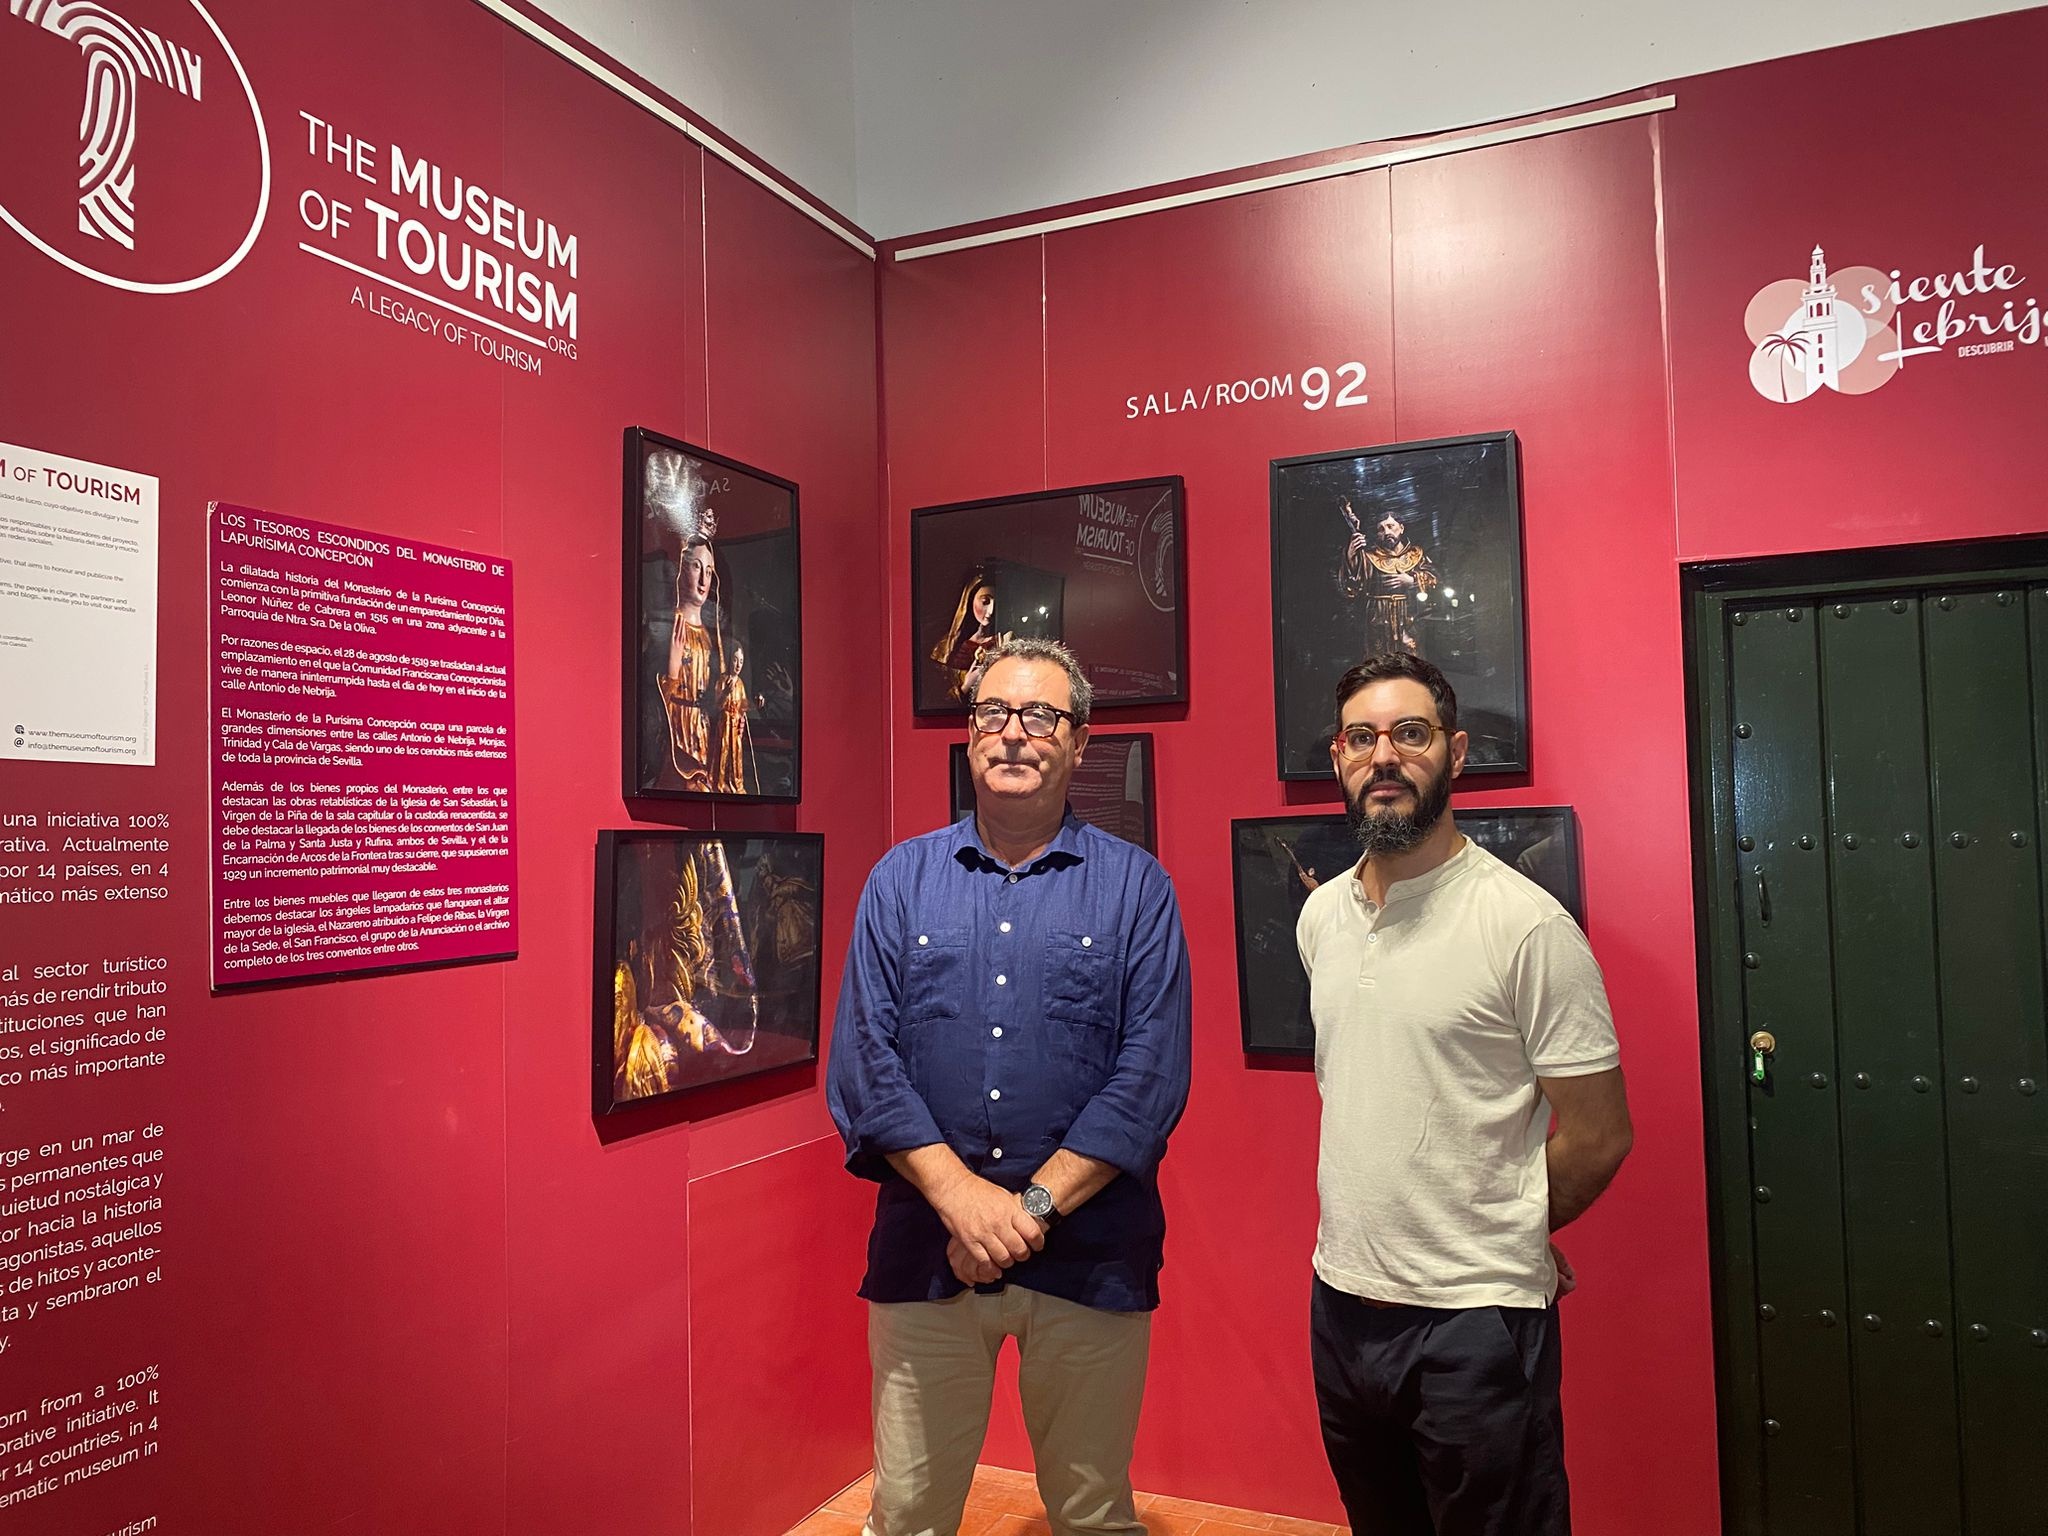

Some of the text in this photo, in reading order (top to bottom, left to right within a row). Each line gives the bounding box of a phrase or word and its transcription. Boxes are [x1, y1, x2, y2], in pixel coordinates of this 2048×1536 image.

[299, 110, 577, 279] THE MUSEUM
[299, 189, 577, 340] OF TOURISM
[1860, 244, 2026, 314] siente
[350, 286, 541, 376] A LEGACY OF TOURISM
[1958, 340, 2014, 358] DESCUBRIR
[1300, 361, 1369, 411] 92
[13, 466, 38, 484] OF
[42, 467, 141, 506] TOURISM
[220, 511, 505, 577] LOS TESOROS ESCONDIDOS DEL MONASTERIO DE
[297, 543, 374, 569] CONCEPCIÓN
[220, 560, 506, 615] La dilatada historia del Monasterio de la Purísima Concepción
[220, 604, 378, 635] Parroquia de Ntra. Sra. De la Oliva.
[220, 678, 337, 699] calle Antonio de Nebrija.
[27, 730, 137, 744] www.themuseumoftourism.org
[221, 751, 364, 767] de toda la provincia de Sevilla.
[3, 811, 170, 829] una iniciativa 100%
[62, 836, 170, 852] Actualmente
[37, 864, 57, 880] 14
[65, 860, 123, 881] países,
[130, 863, 152, 876] en
[158, 862, 169, 877] 4
[222, 861, 439, 882] 1929 un incremento patrimonial muy destacable.
[61, 885, 98, 902] más
[104, 885, 169, 901] extenso
[1, 955, 168, 982] al sector turístico
[223, 941, 420, 970] completo de los tres conventos entre otros.
[32, 987, 57, 1005] de
[60, 983, 112, 1002] rendir
[113, 979, 167, 998] tributo
[94, 1009, 128, 1027] que
[136, 1003, 166, 1019] han
[28, 1038, 47, 1057] el
[49, 1029, 141, 1057] significado
[144, 1026, 167, 1043] de
[30, 1062, 68, 1082] más
[75, 1051, 166, 1077] importante
[39, 1142, 62, 1157] en
[71, 1136, 93, 1152] un
[102, 1129, 136, 1147] mar
[142, 1122, 164, 1139] de
[11, 1155, 128, 1193] permanentes
[131, 1149, 164, 1168] que
[1, 1172, 164, 1217] uietud nostálgica y
[0, 1195, 162, 1244] or hacia la historia
[91, 1221, 162, 1248] aquellos
[8, 1275, 34, 1294] de
[37, 1265, 80, 1287] hitos
[83, 1261, 95, 1280] y
[97, 1246, 161, 1272] aconte-
[27, 1301, 39, 1320] y
[45, 1275, 139, 1311] sembraron
[146, 1265, 162, 1284] el
[40, 1392, 82, 1416] from
[94, 1385, 105, 1399] a
[116, 1363, 159, 1392] 100%
[66, 1400, 139, 1433] initiative.
[149, 1389, 160, 1406] It
[14, 1459, 34, 1477] 14
[39, 1430, 123, 1468] countries,
[129, 1421, 143, 1437] in
[148, 1416, 159, 1431] 4
[64, 1448, 139, 1486] museum
[144, 1440, 158, 1457] in
[106, 1515, 158, 1536] urism
